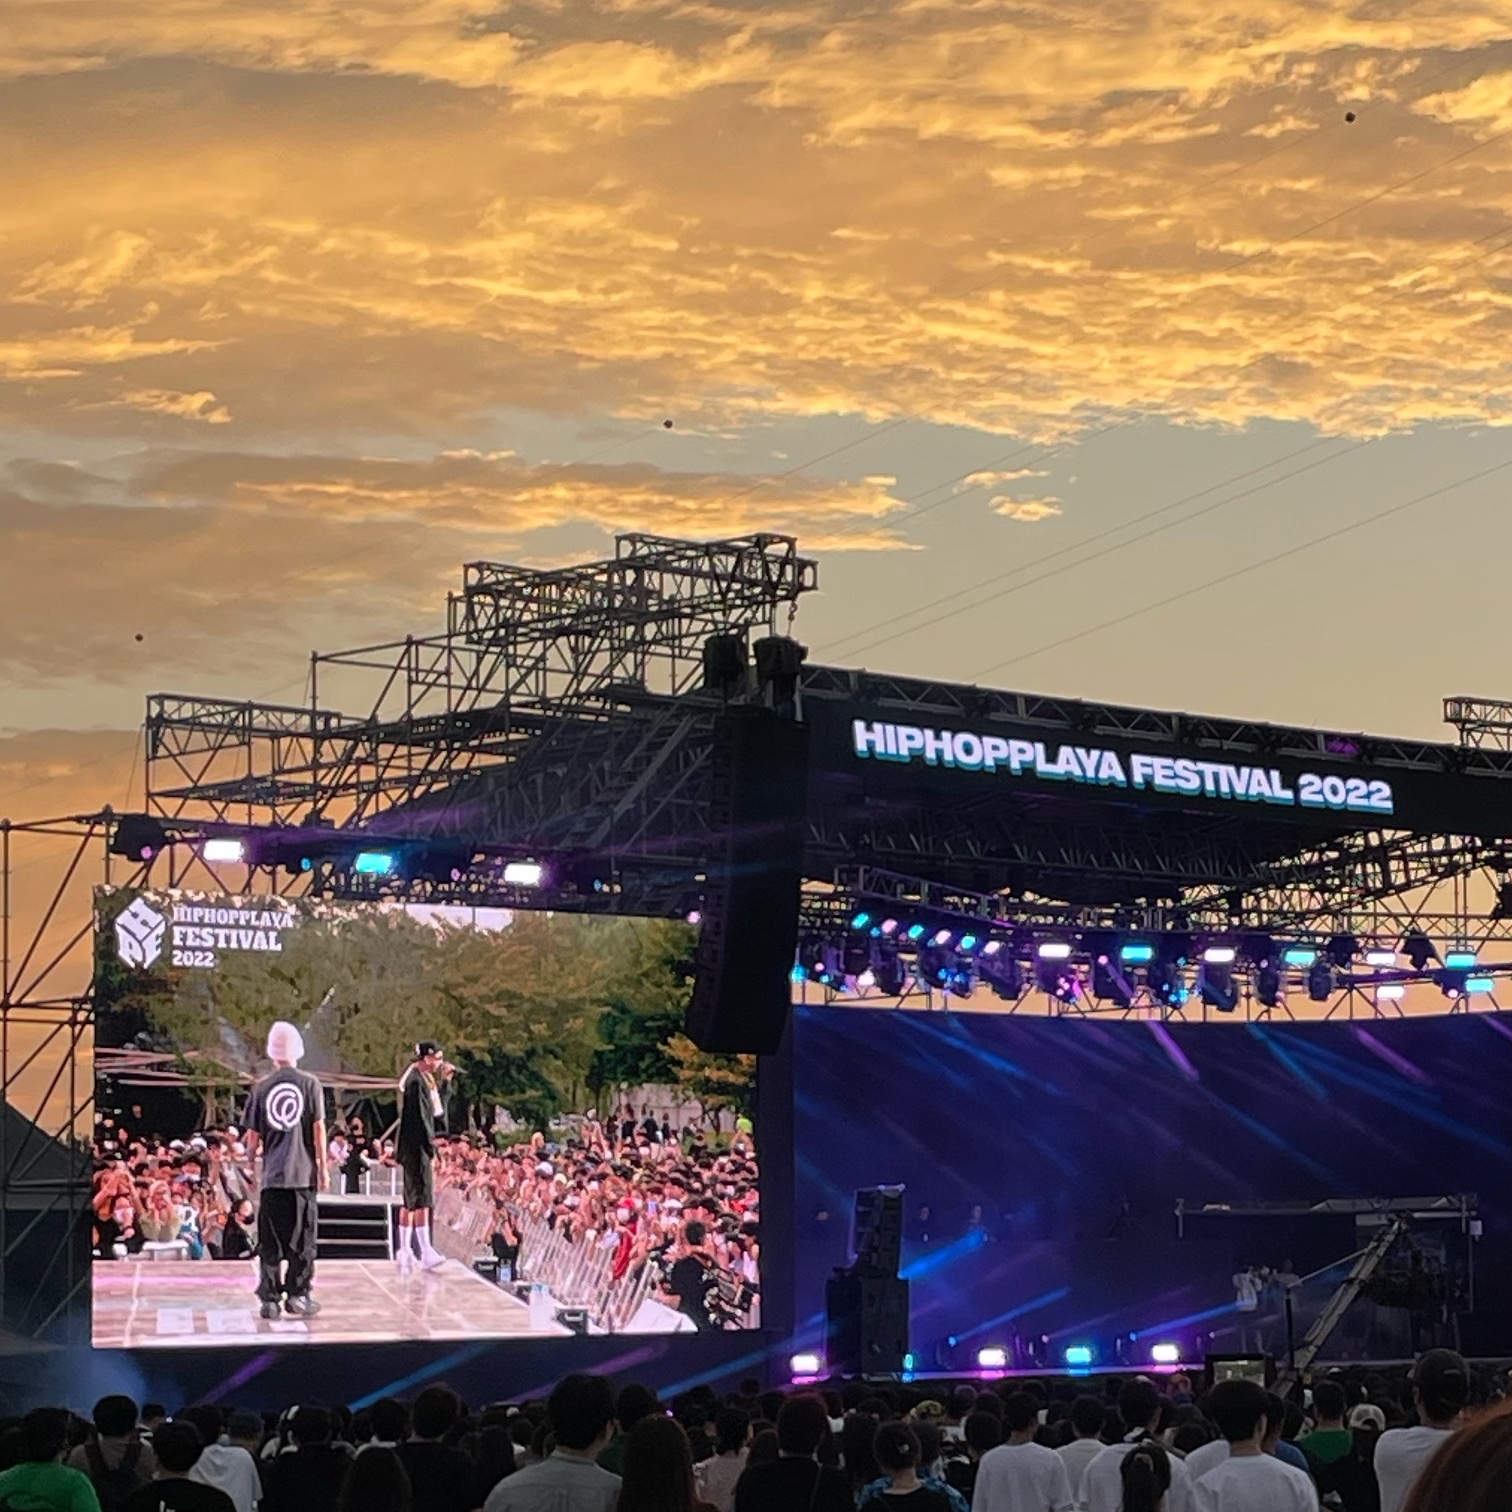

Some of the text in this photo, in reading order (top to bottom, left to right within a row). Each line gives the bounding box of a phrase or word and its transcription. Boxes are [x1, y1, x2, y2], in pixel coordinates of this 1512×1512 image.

[853, 718, 1395, 816] HIPHOPPLAYA FESTIVAL 2022
[172, 904, 294, 929] HIPHOPPLAYA
[172, 925, 283, 951] FESTIVAL
[172, 949, 215, 968] 2022
